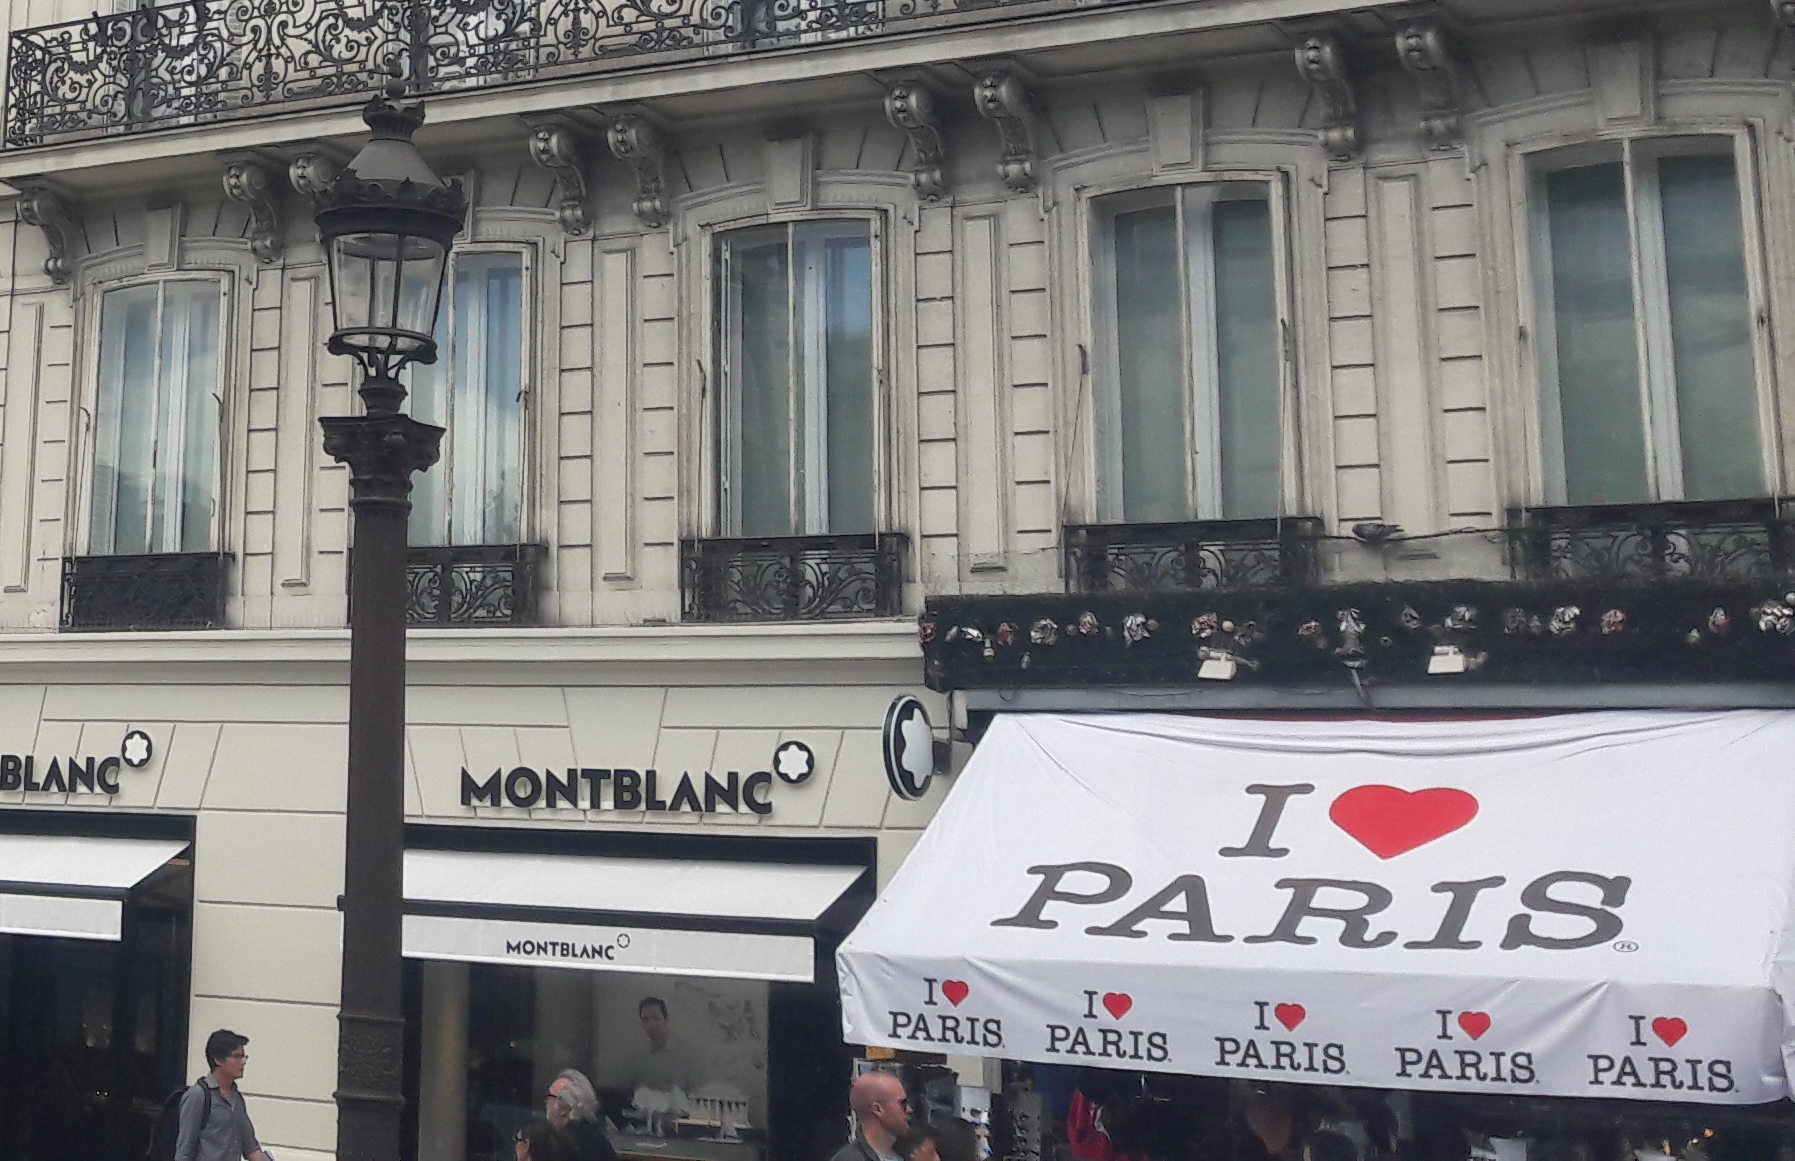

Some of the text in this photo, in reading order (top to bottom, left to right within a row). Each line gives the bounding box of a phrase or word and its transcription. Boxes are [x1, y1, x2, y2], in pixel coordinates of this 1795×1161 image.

[460, 766, 773, 816] MONTBLANC
[1218, 783, 1315, 858] I
[990, 861, 1632, 951] PARIS
[506, 940, 615, 961] MONTBLANC
[922, 977, 938, 1006] I
[1083, 989, 1099, 1020] I
[887, 1010, 1003, 1049] PARIS
[1253, 1000, 1271, 1031] I
[1435, 1009, 1454, 1041] I
[1627, 1014, 1648, 1047] I
[1045, 1023, 1170, 1064] PARIS
[1214, 1036, 1346, 1075] PARIS
[1394, 1047, 1536, 1085] PARIS
[1586, 1054, 1735, 1093] PARIS
